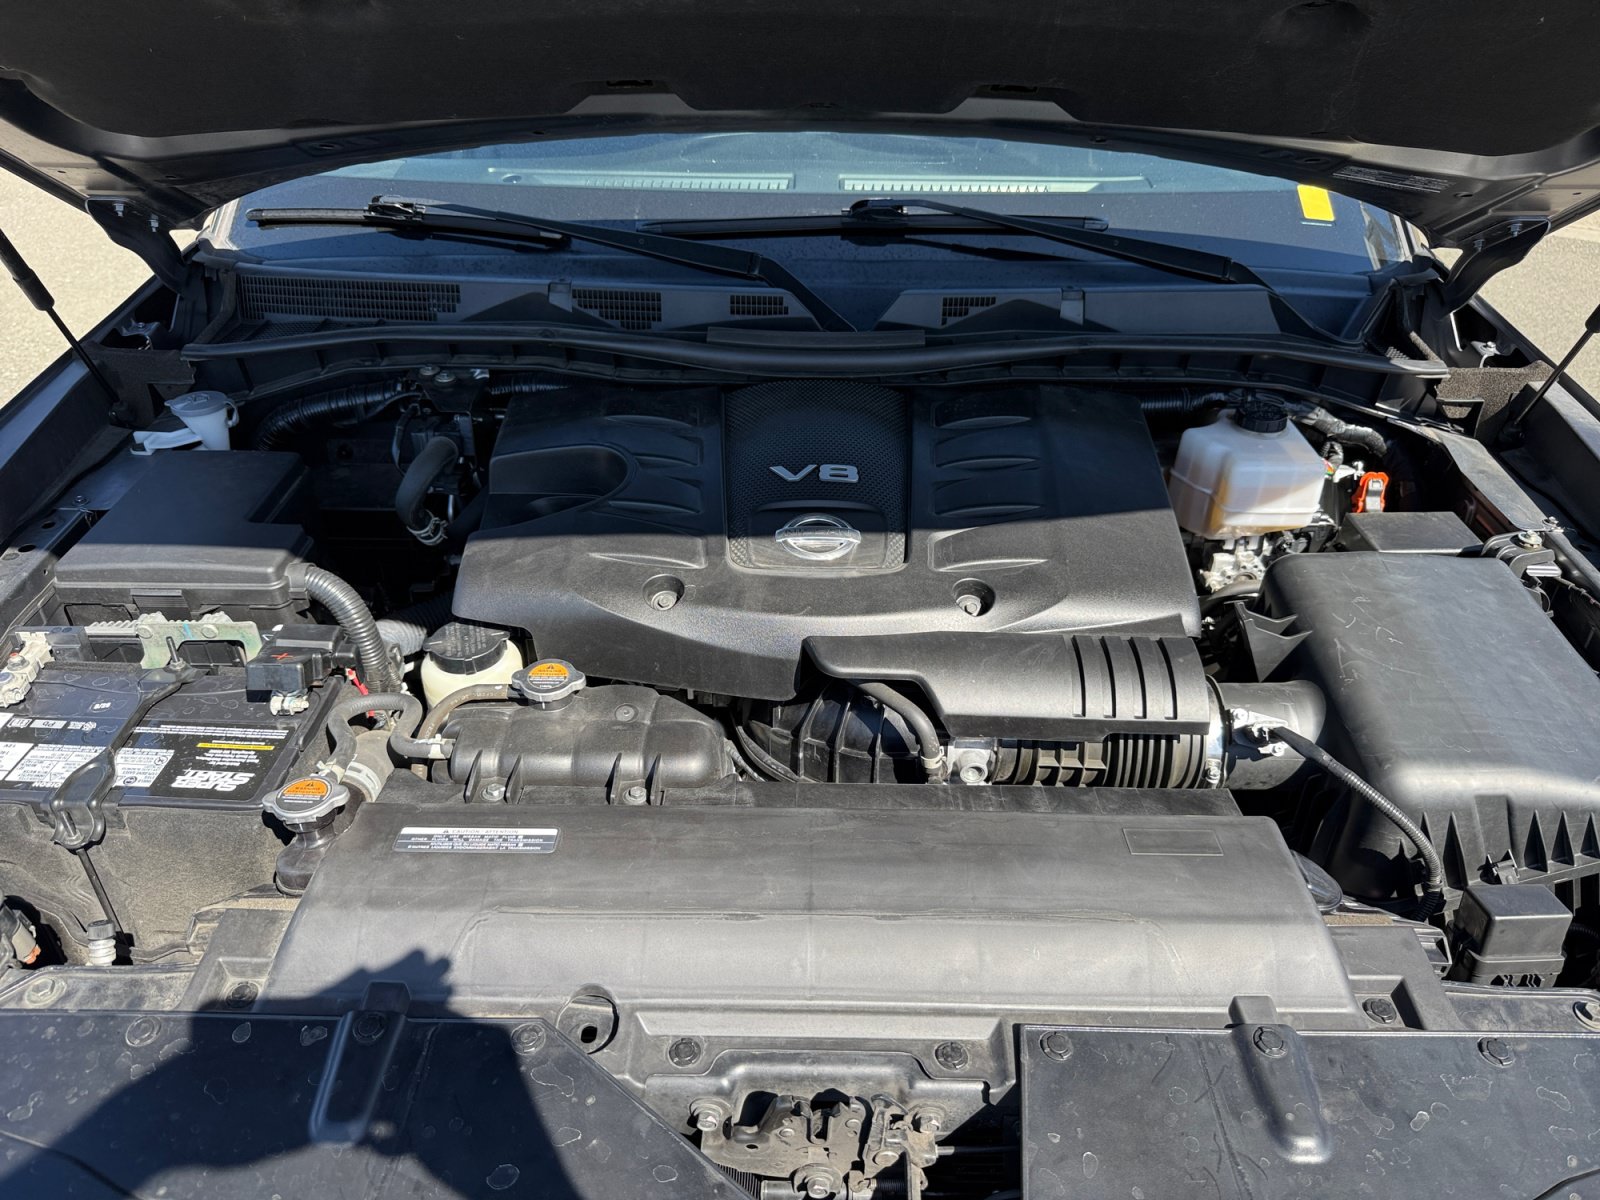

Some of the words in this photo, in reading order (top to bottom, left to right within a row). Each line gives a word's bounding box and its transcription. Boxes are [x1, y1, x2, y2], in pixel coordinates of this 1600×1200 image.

[769, 463, 859, 483] V8
[176, 770, 255, 785] START
[170, 779, 237, 792] SUPER
